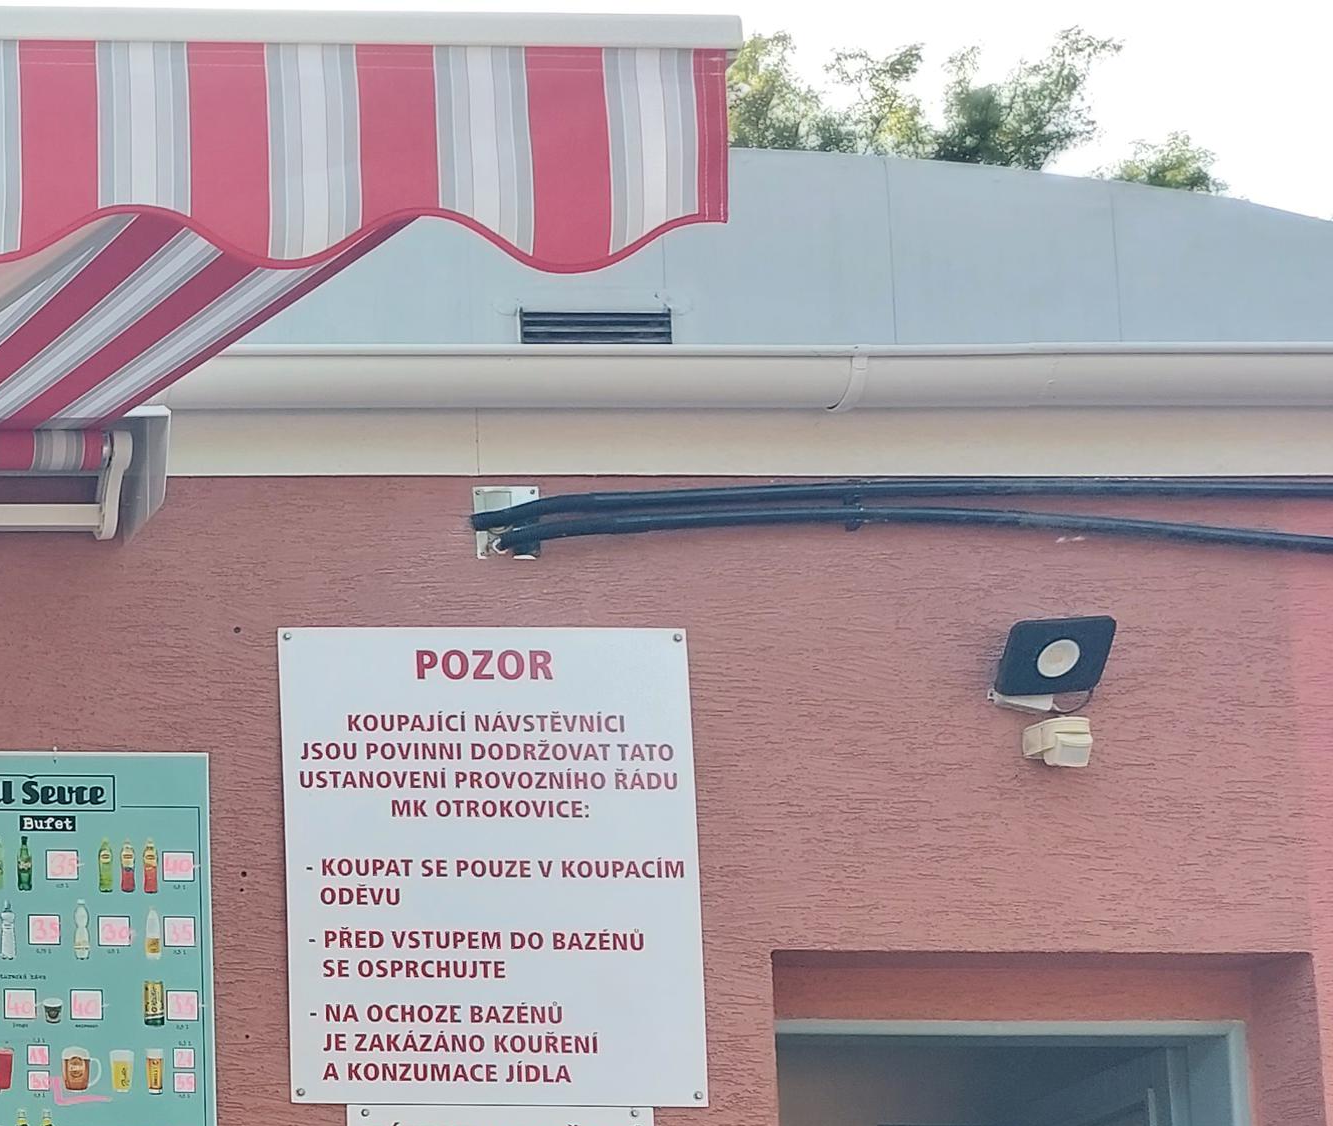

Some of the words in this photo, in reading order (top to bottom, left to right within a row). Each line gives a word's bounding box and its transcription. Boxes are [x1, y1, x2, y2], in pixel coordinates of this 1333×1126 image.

[415, 648, 554, 681] POZOR
[346, 711, 467, 733] KOUPAJÍCÍ
[300, 742, 361, 761] JSOU
[365, 743, 463, 761] POVINNI
[470, 738, 611, 762] DODRŽOVAT
[617, 744, 674, 762] TATO
[298, 767, 448, 790] USTANOVENÍ
[454, 767, 607, 791] PROVOZNÍHO
[614, 768, 679, 791] ŘÁDU
[390, 799, 427, 818] MK
[435, 799, 590, 819] OTROKOVICE:
[23, 817, 73, 830] Bufet
[321, 858, 413, 877] KOUPAT
[420, 858, 448, 878] SE
[456, 859, 532, 878] POUZE
[537, 859, 553, 878] V
[561, 856, 685, 879] KOUPACÍM
[320, 882, 401, 905] ODĚVU
[324, 926, 384, 950] PŘED
[390, 930, 502, 950] VSTUPEM
[510, 930, 544, 951] DO
[552, 927, 645, 952] BAZÉNŮ
[322, 959, 351, 979] SE
[357, 960, 506, 979] OSPRCHUJTE
[325, 1004, 359, 1023] NA
[367, 1004, 462, 1024] OCHOZE
[469, 1001, 563, 1024] BAZÉNŮ
[323, 1033, 347, 1053] JE
[353, 1029, 486, 1054] ZAKÁZÁNO
[494, 1030, 598, 1054] KOUŘENÍ
[323, 1063, 338, 1081] A
[346, 1063, 498, 1082] KONZUMACE
[505, 1059, 571, 1083] JÍDLA
